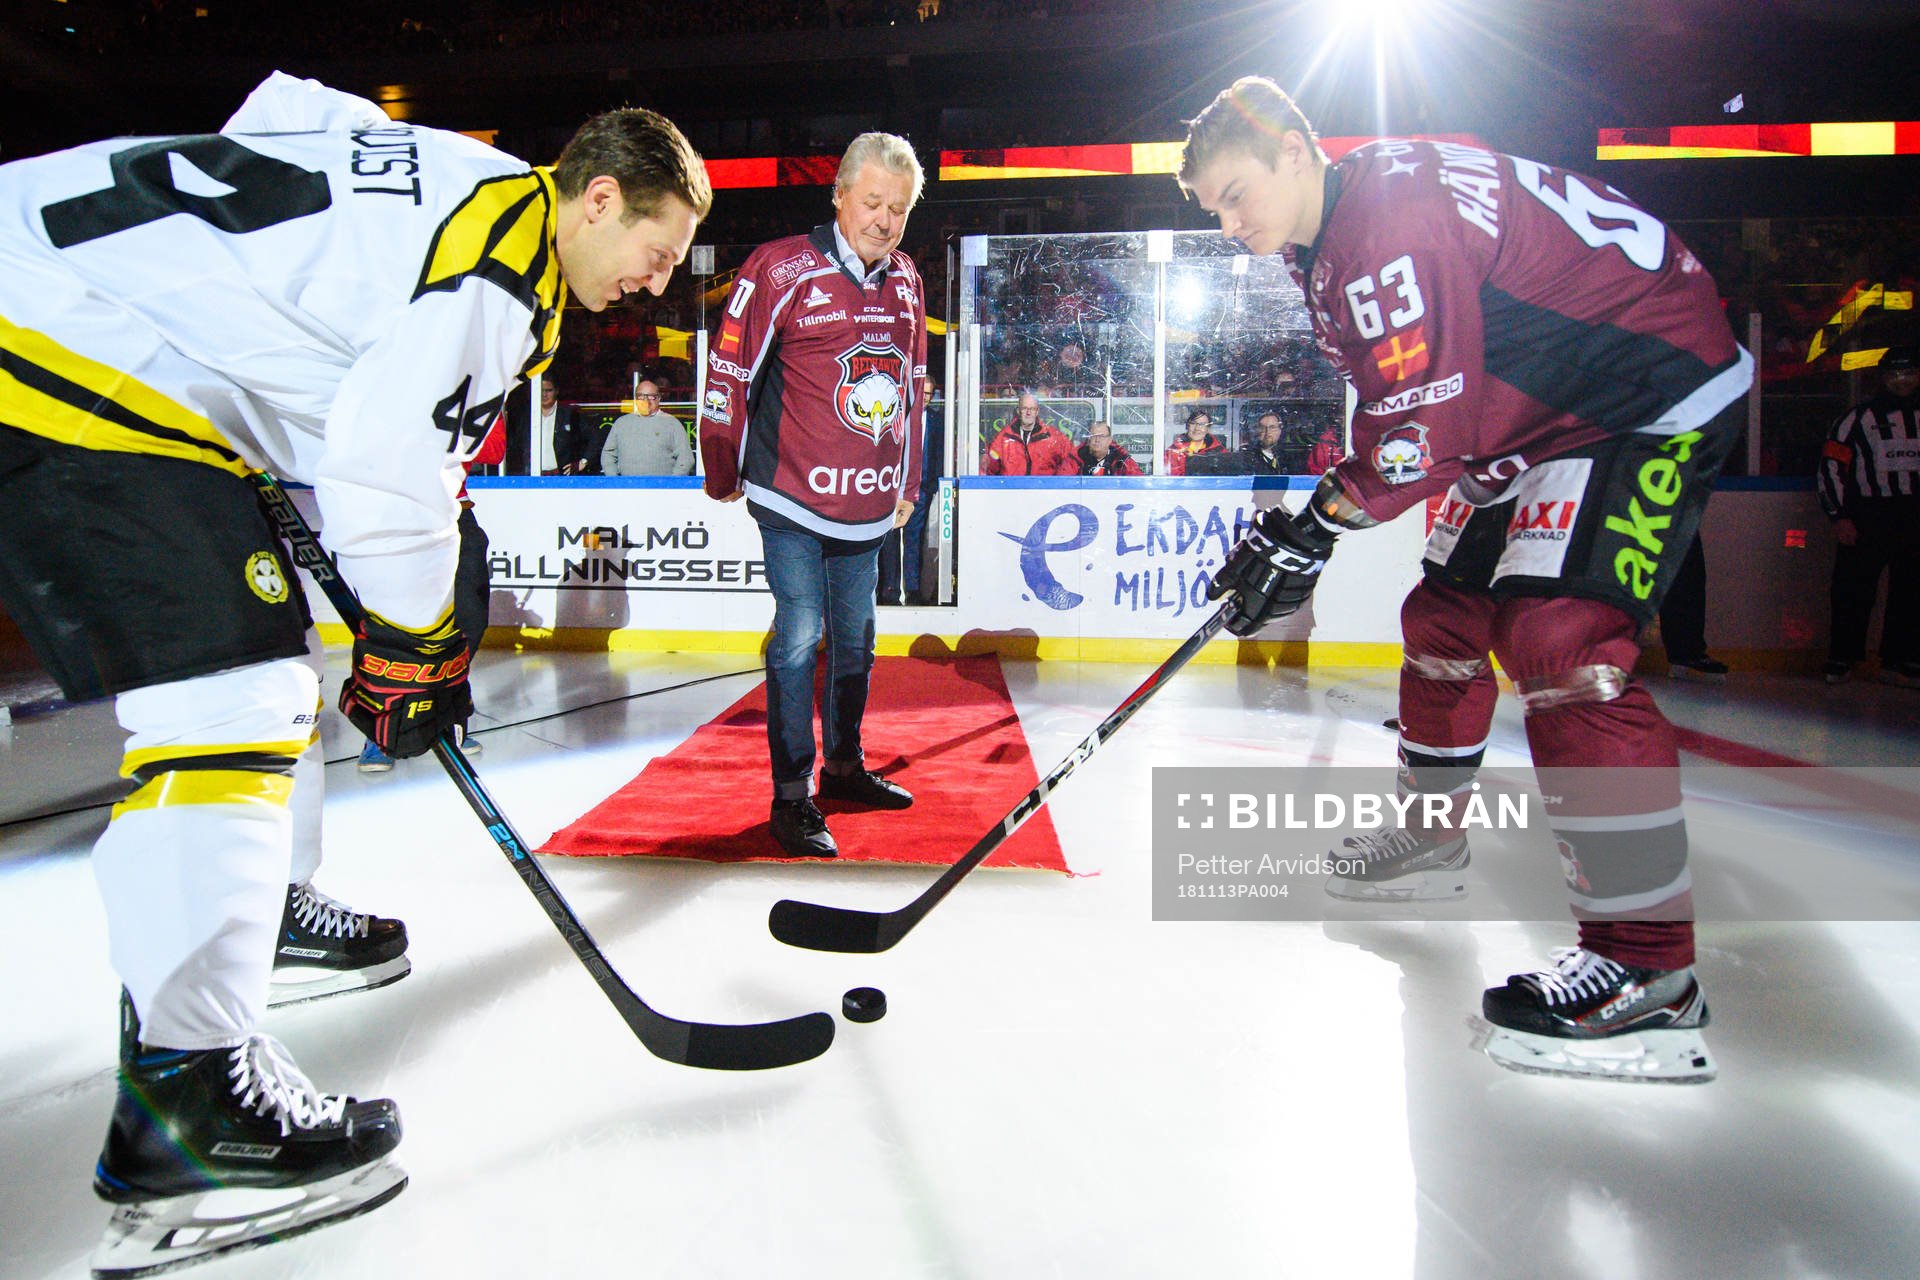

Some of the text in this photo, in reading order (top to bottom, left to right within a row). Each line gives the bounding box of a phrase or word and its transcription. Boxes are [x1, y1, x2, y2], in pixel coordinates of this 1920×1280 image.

[1344, 254, 1425, 340] 63
[796, 309, 847, 328] Tillmobil
[863, 332, 892, 343] MALMÖ
[431, 373, 506, 455] 44
[942, 487, 952, 540] DACO
[557, 521, 710, 551] MALMÖ
[1600, 986, 1645, 1021] CCM
